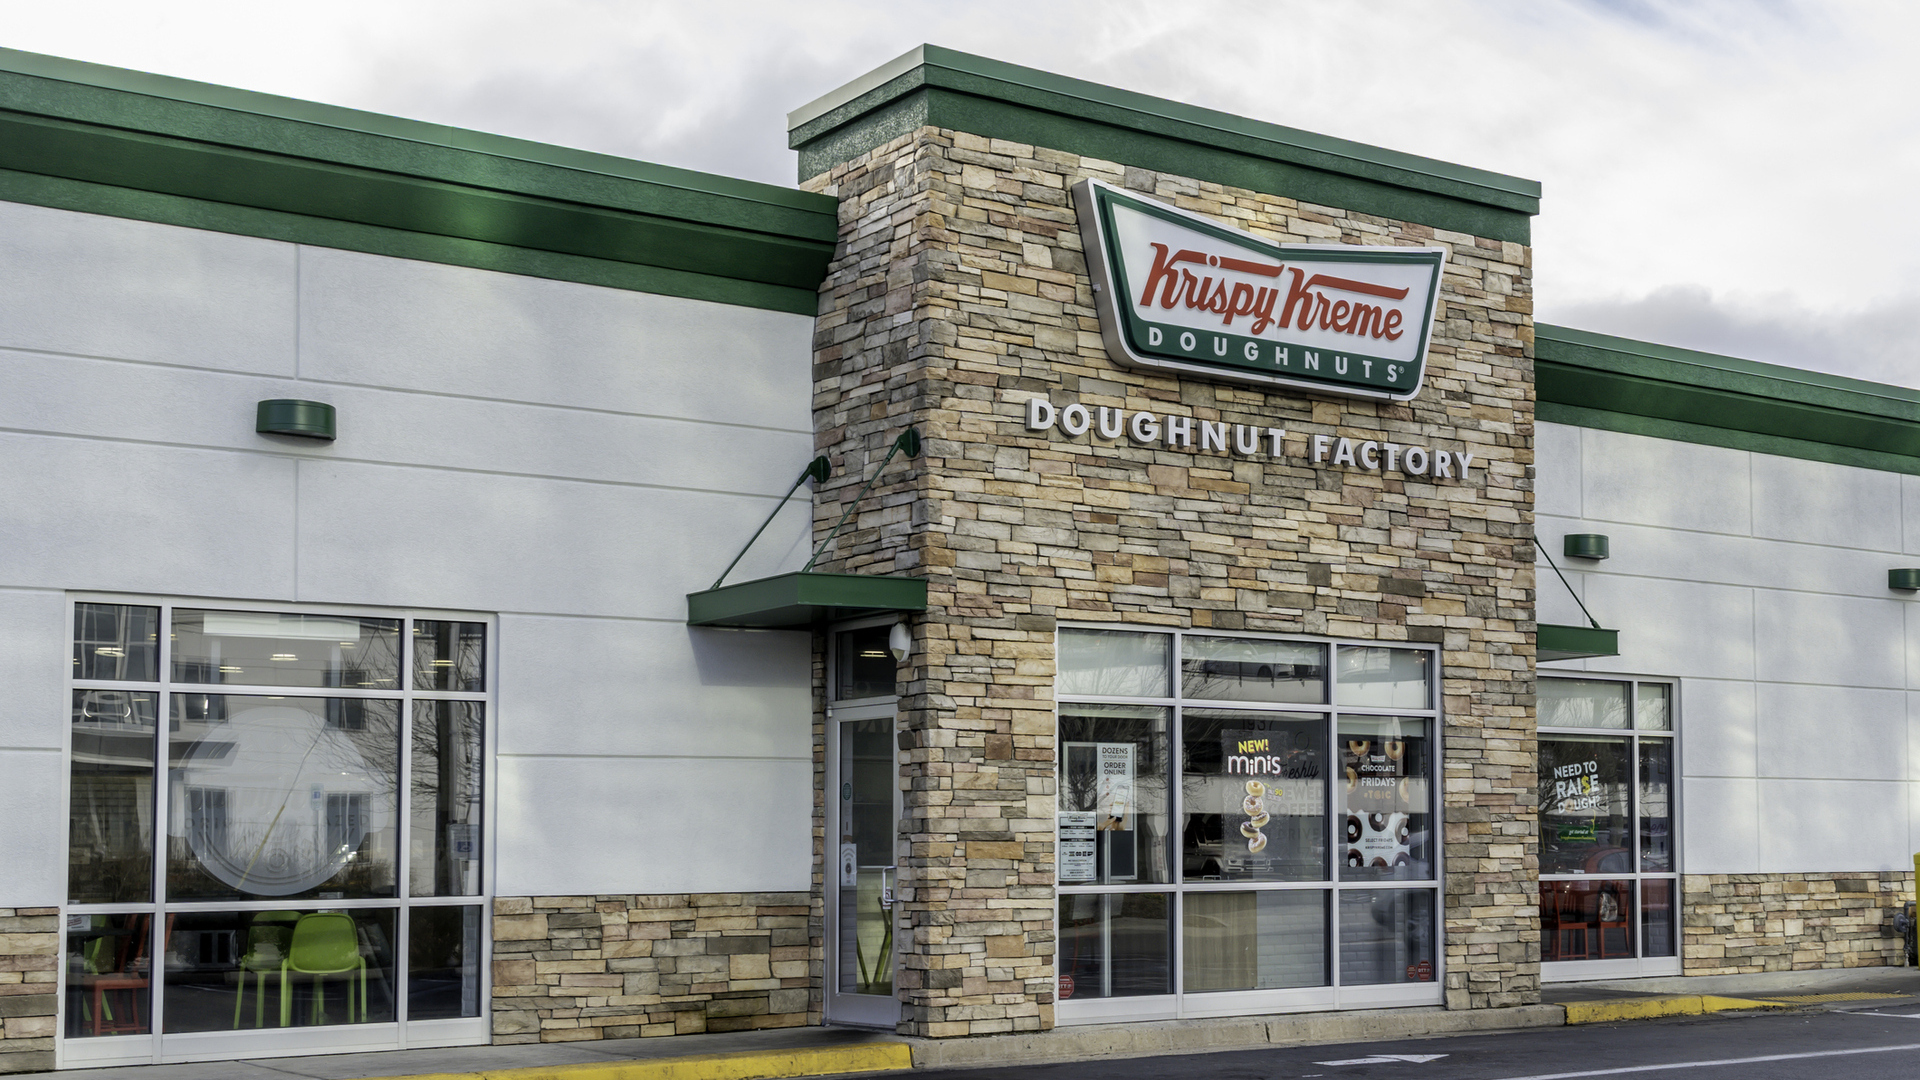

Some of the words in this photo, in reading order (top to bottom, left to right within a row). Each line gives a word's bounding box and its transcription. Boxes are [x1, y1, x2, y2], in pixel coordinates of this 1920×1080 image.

[1139, 242, 1285, 335] Krispy
[1278, 267, 1410, 341] Kreme
[1026, 398, 1285, 458] DOUGHNUT
[1309, 434, 1474, 479] FACTORY
[1102, 747, 1128, 755] DOZENS
[1238, 739, 1270, 754] NEW!
[1227, 755, 1282, 775] minis
[1553, 763, 1582, 779] NEED
[1583, 760, 1597, 774] TO
[1361, 777, 1396, 787] FRIDAYS
